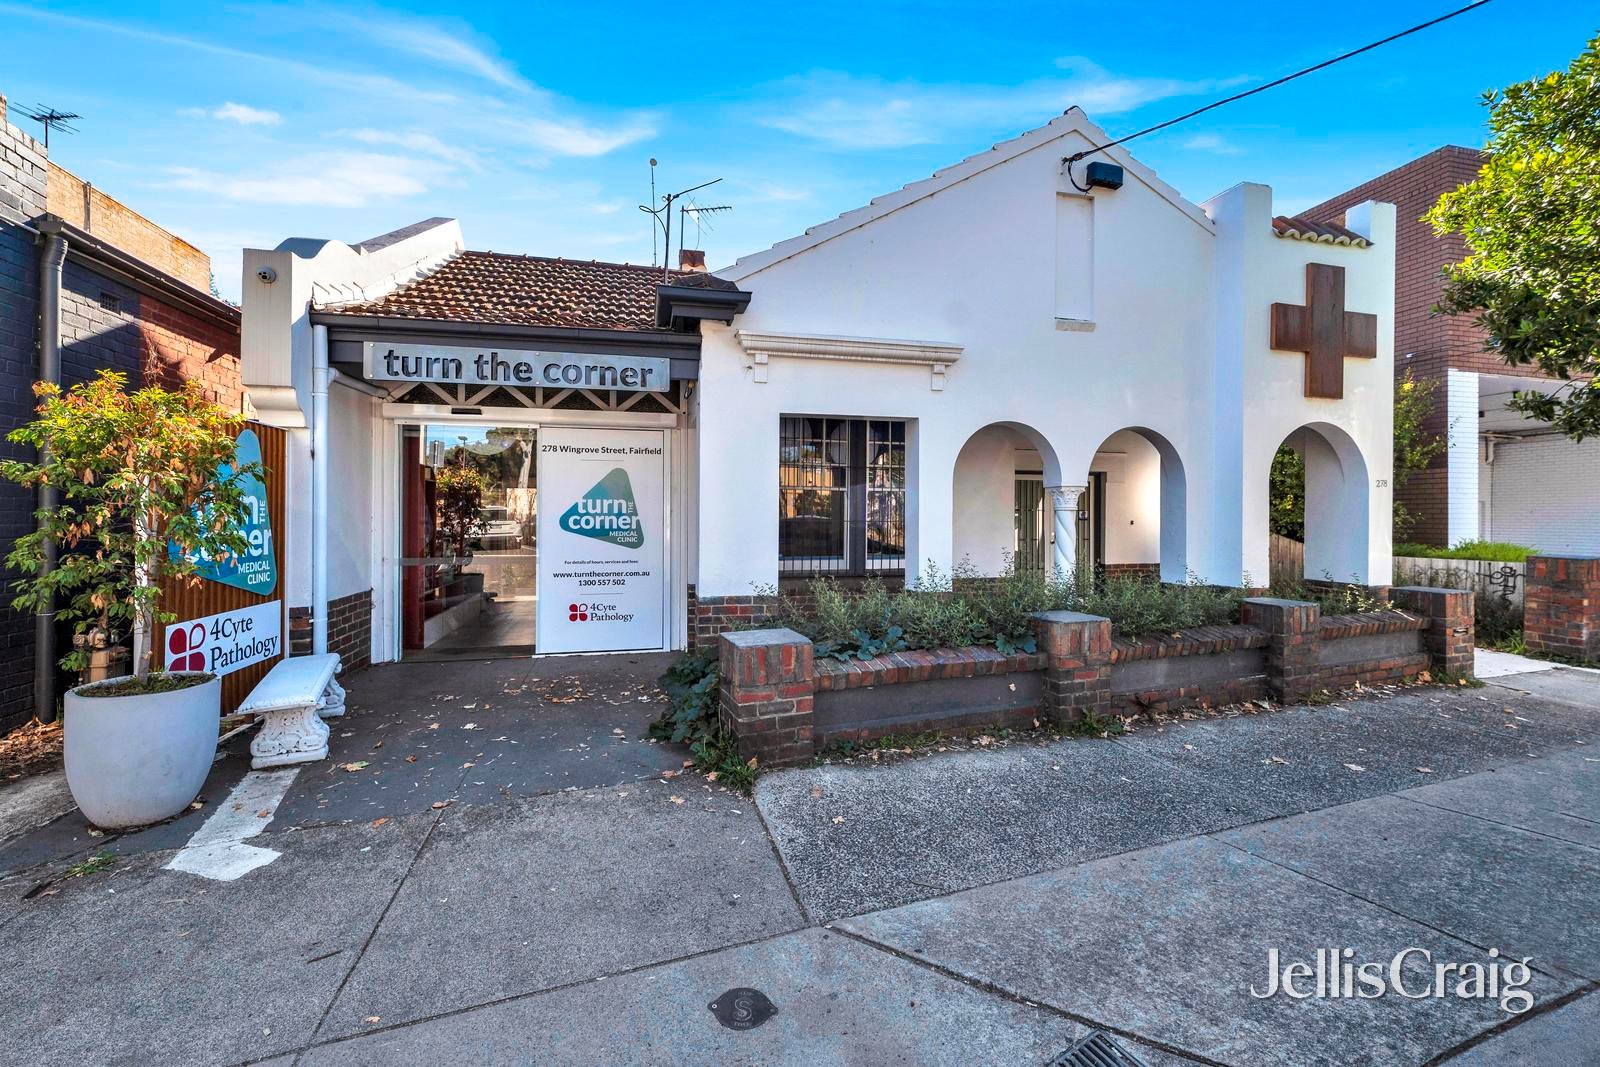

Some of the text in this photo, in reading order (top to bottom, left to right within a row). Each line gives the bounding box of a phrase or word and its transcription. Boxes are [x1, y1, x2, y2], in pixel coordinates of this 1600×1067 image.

[384, 349, 653, 388] turn the corner
[542, 445, 662, 455] 278 Wingrove Street, Fairfield
[1376, 480, 1388, 488] 278
[577, 498, 627, 514] turn
[568, 515, 639, 529] corner
[238, 560, 271, 574] MEDICAL
[247, 572, 271, 585] CLINIC
[552, 570, 650, 579] www.turnthecorner.com.au
[590, 603, 617, 613] 4Cyte
[590, 612, 634, 622] Pathology
[209, 615, 254, 642] 4Cyte
[209, 635, 278, 672] Pathology
[734, 997, 754, 1022] S
